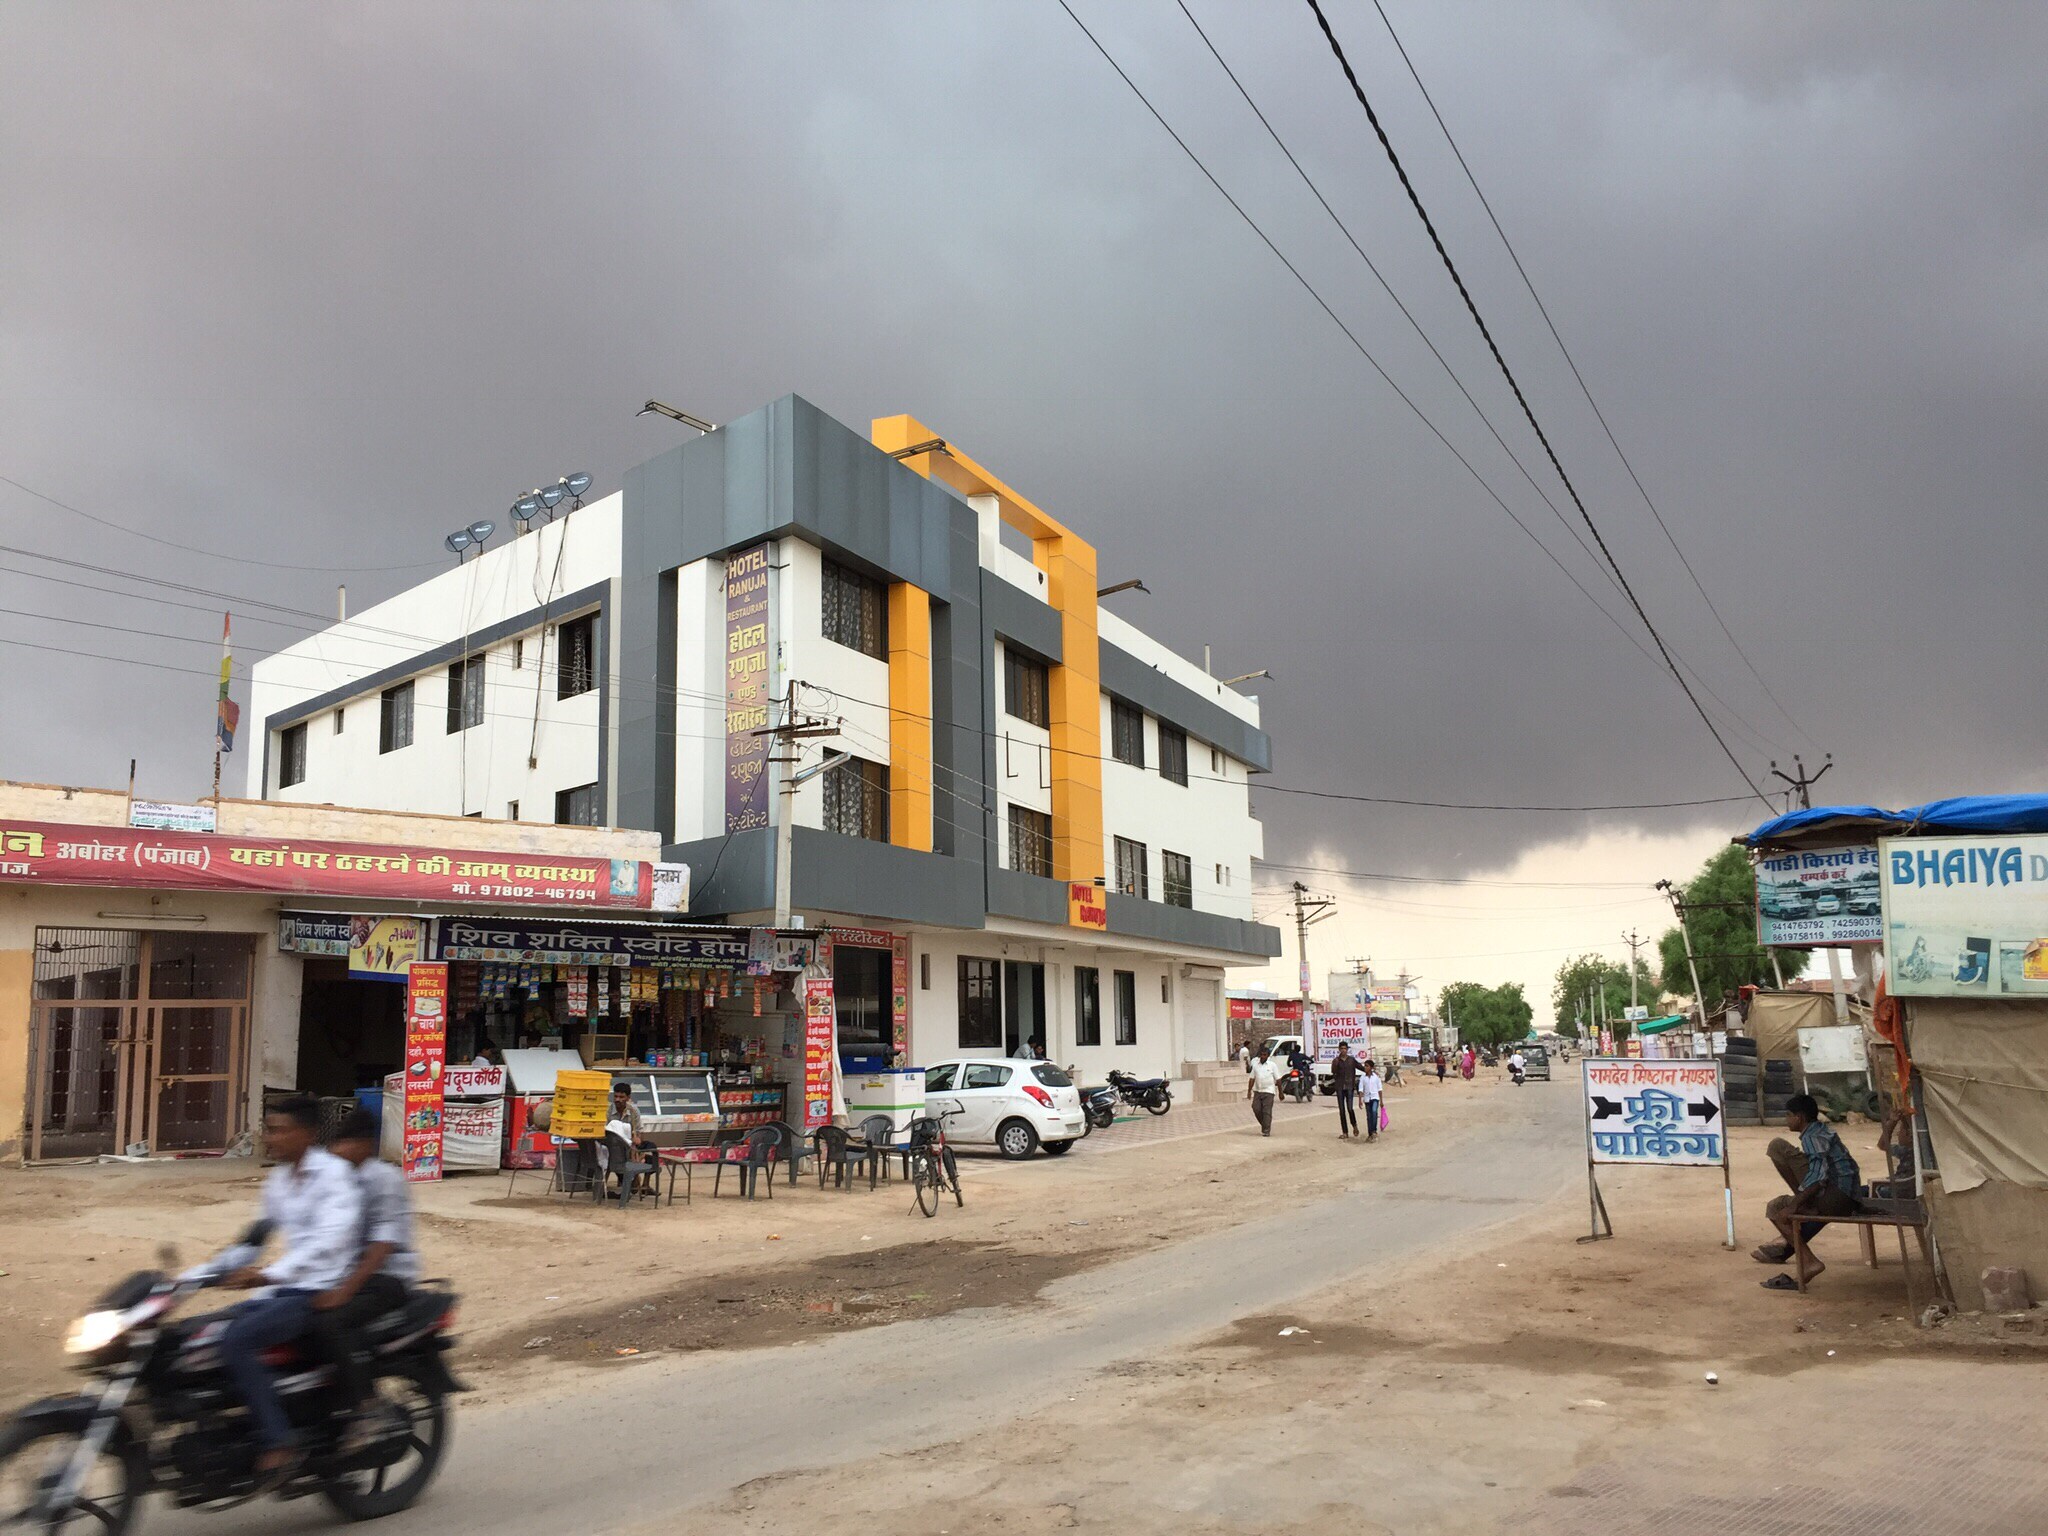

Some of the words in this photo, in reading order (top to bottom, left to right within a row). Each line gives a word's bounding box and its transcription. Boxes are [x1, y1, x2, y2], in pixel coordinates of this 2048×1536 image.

[728, 549, 767, 580] HOTEL
[728, 572, 767, 599] RANUJA
[743, 594, 751, 603] &
[727, 600, 768, 622] RESTAURANT
[728, 622, 766, 654] होटल
[728, 650, 767, 682] रणुजा
[730, 737, 764, 758] હોટલ
[56, 839, 128, 862] अबोहर
[134, 842, 211, 870] (पंजाब)
[229, 845, 288, 867] यहां
[292, 852, 330, 869] पर
[335, 853, 412, 874] ठहरने
[416, 855, 452, 876] की
[515, 864, 596, 884] व्यवस्था
[1764, 855, 1800, 872] गाडी
[1801, 849, 1855, 869] किराये
[1891, 847, 2023, 888] BHAIYA
[1800, 869, 1829, 882] सम्पर्क
[452, 881, 475, 896] मो.
[480, 884, 596, 900] 97802-46794
[296, 918, 312, 937] शिव
[314, 919, 337, 938] शक्ति
[1772, 920, 1824, 930] 9414763792
[1773, 932, 1824, 941] 8619758119
[1832, 929, 1884, 938] 992860014
[447, 923, 520, 946] शिव
[526, 929, 614, 950] शक्ति
[698, 938, 748, 957] होम
[411, 989, 444, 997] चमचम
[419, 1019, 435, 1030] चाय
[1325, 1018, 1357, 1026] HOTEL
[1322, 1028, 1362, 1038] RANUJA
[407, 1078, 434, 1090] लस्सी
[1590, 1063, 1629, 1086] रामदेव
[1632, 1064, 1677, 1085] मिष्टान
[1679, 1068, 1717, 1086] भण्डार
[1624, 1088, 1684, 1124] फ्री
[1593, 1121, 1721, 1159] पार्किंग
